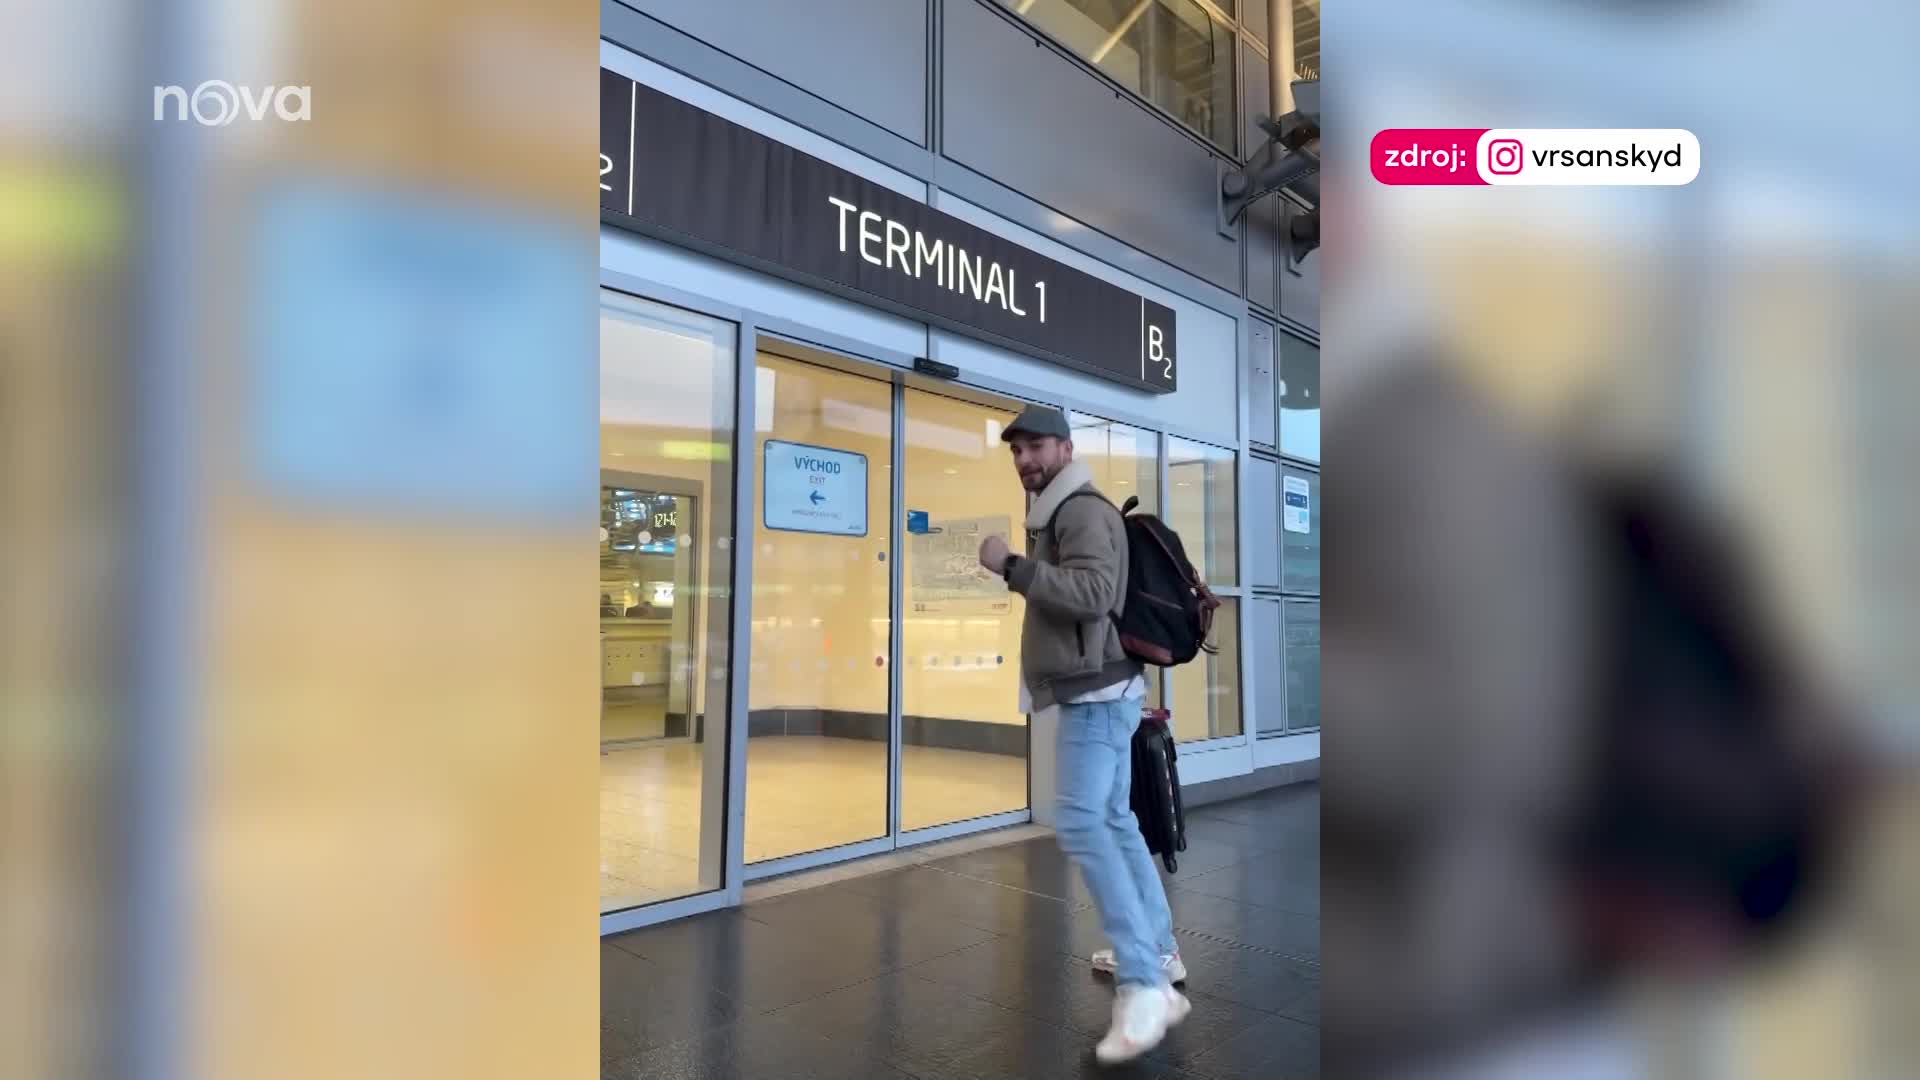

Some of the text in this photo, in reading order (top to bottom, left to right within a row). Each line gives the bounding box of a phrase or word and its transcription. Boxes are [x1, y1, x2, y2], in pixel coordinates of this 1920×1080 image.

[828, 196, 1046, 323] TERMINAL 1
[794, 455, 841, 474] VÝCHOD
